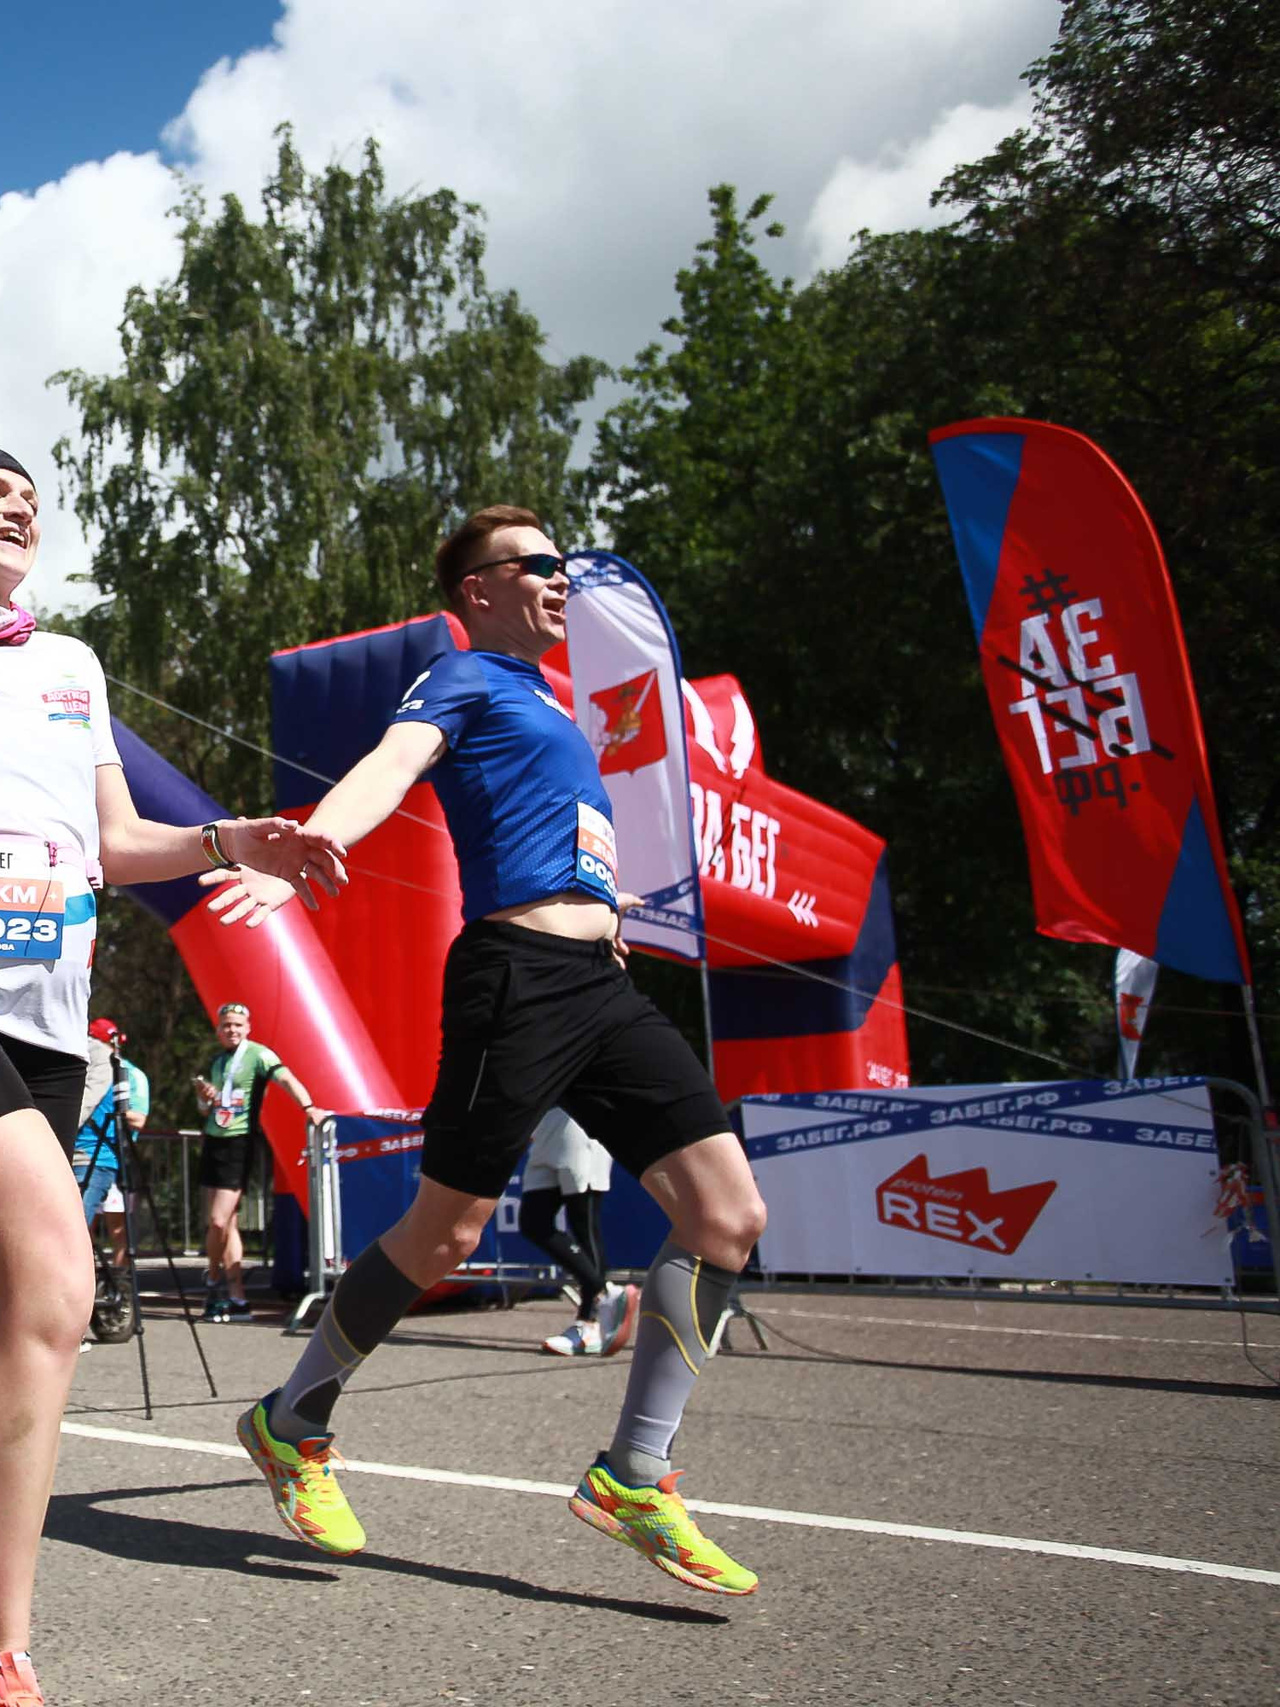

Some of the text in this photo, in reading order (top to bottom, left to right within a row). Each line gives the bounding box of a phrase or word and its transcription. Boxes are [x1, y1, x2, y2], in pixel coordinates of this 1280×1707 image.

[731, 801, 781, 900] БЕГ
[929, 1091, 1060, 1125] ЗАБЕГ.РФ
[776, 1119, 892, 1151] ЗАБЕГ.РФ
[1135, 1127, 1216, 1149] ЗАБЕ
[882, 1191, 1007, 1250] REX
